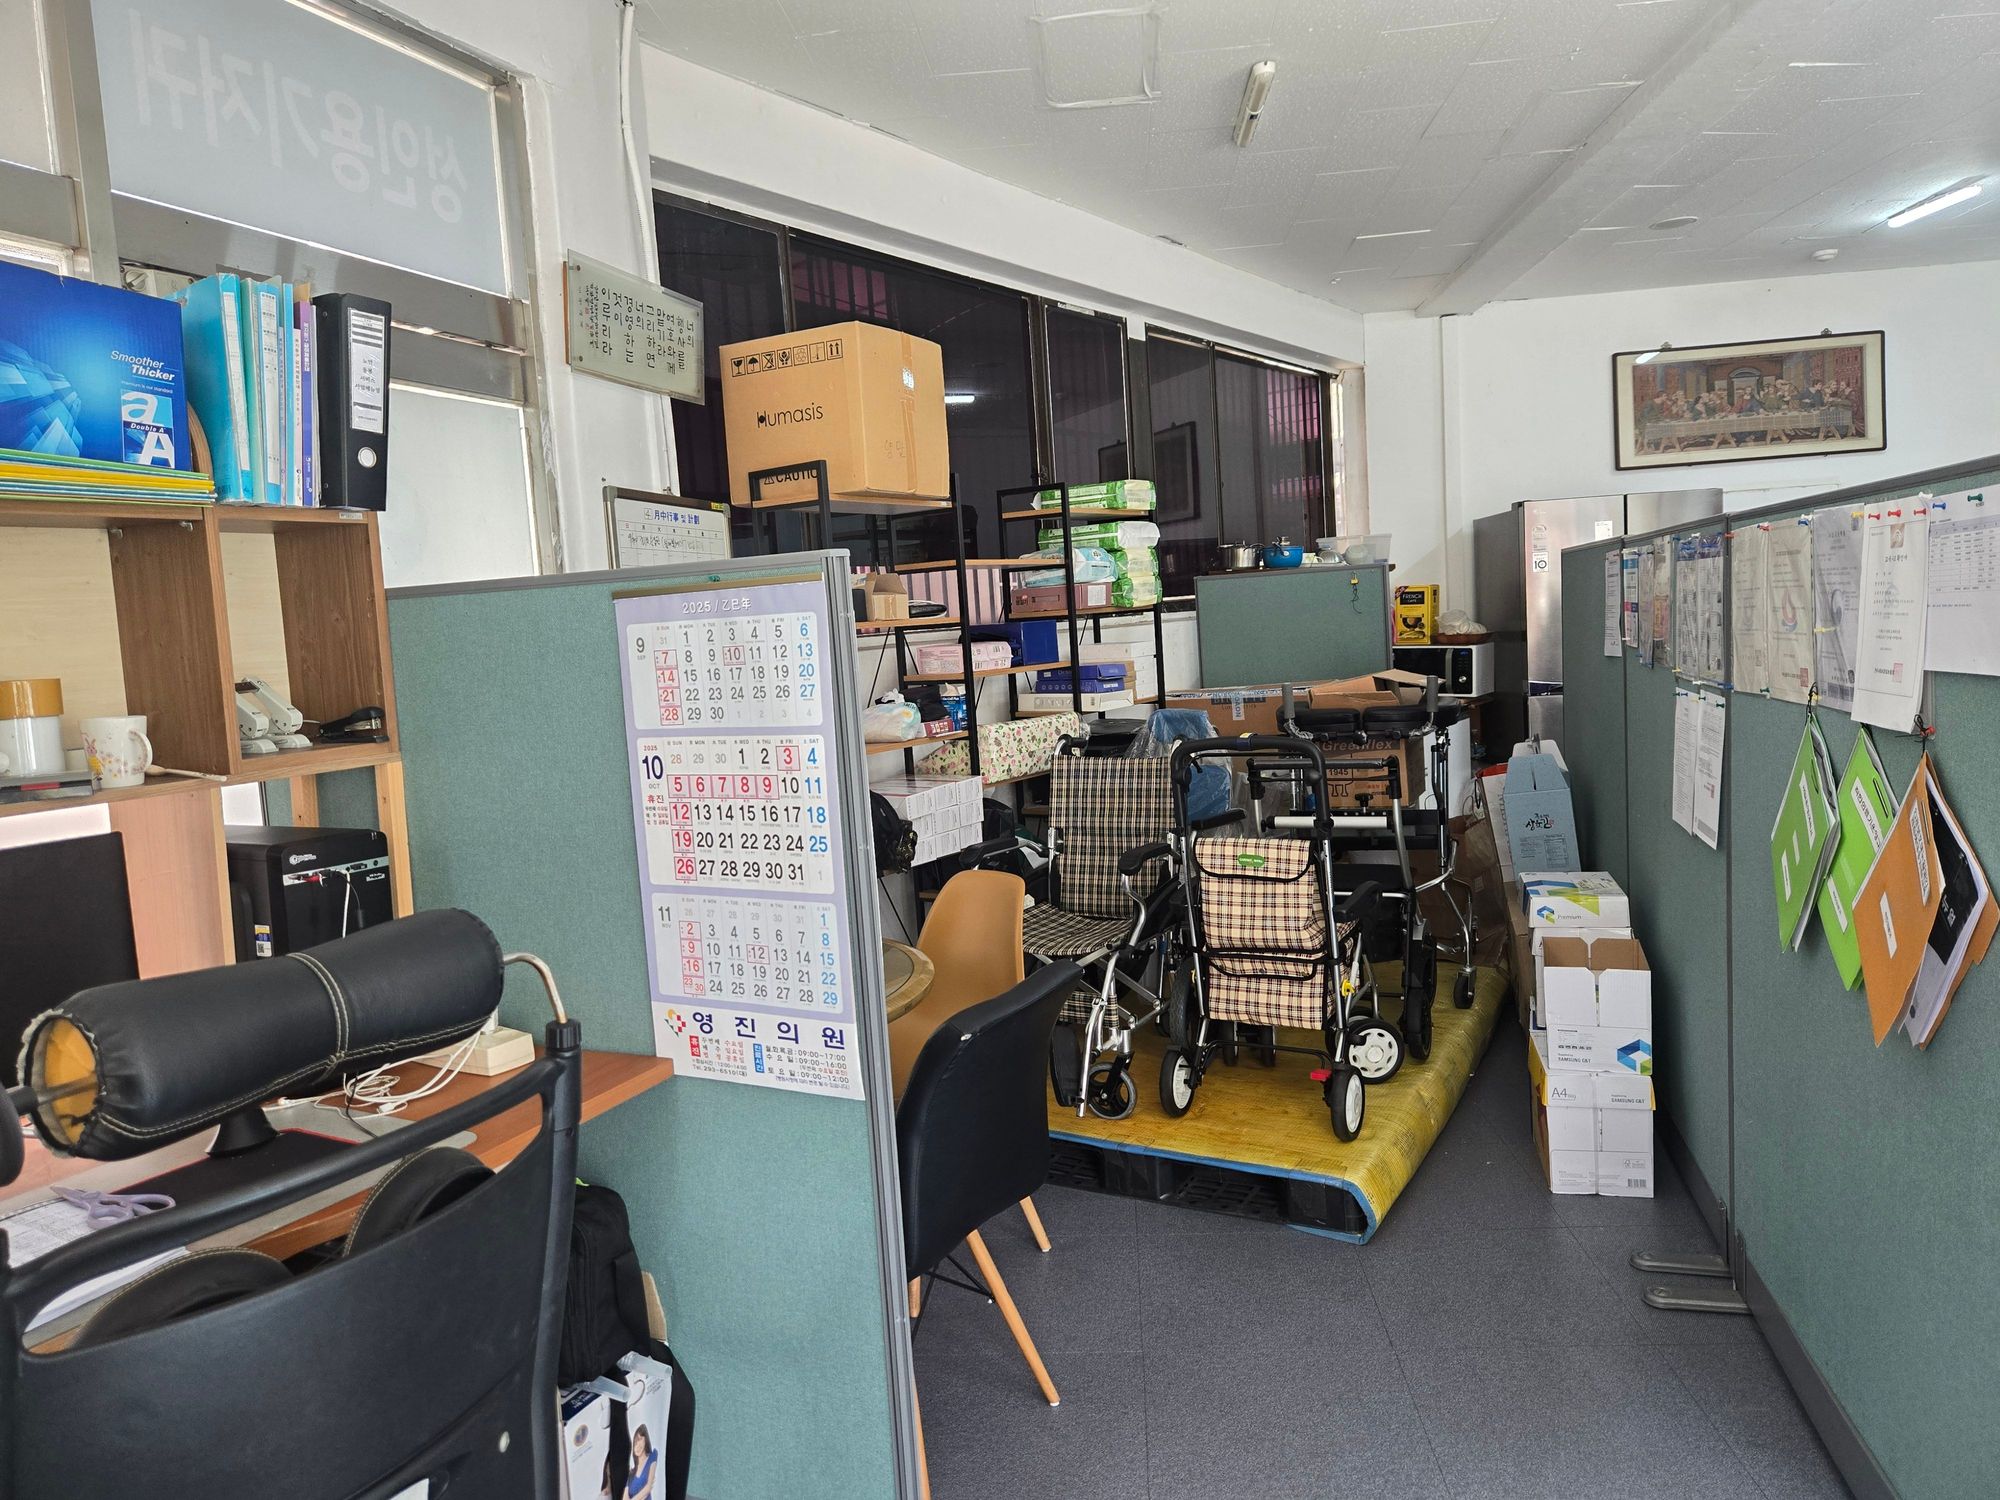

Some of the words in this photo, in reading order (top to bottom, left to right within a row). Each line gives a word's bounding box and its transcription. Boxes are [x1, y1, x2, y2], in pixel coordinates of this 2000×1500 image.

[601, 287, 612, 356] 이루리라
[636, 301, 644, 330] 너의
[686, 320, 694, 348] 너의
[110, 350, 164, 369] Smoother
[132, 364, 174, 381] Thicker
[757, 403, 824, 428] Humasis
[130, 422, 157, 432] Double
[776, 470, 818, 483] CAUTIO
[683, 602, 711, 614] 2025
[722, 598, 752, 611] 乙巳年
[636, 637, 645, 653] 9
[684, 631, 688, 644] 1
[707, 629, 714, 642] 2
[728, 628, 735, 641] 3
[751, 626, 758, 639] 4
[775, 625, 782, 638] 5
[800, 623, 808, 636] 6
[662, 652, 668, 664] 7
[685, 650, 692, 663] 8
[708, 648, 715, 662] 9
[727, 647, 740, 661] 10
[749, 646, 761, 660] 11
[772, 644, 788, 658] 12
[798, 643, 813, 657] 13
[660, 670, 675, 683] 14
[684, 669, 697, 682] 15
[707, 668, 720, 681] 16
[729, 667, 742, 680] 17
[751, 666, 765, 679] 18
[774, 665, 789, 678] 19
[799, 663, 814, 677] 20
[662, 689, 674, 702] 21
[685, 688, 700, 701] 22
[708, 687, 722, 700] 23
[730, 686, 744, 700] 24
[752, 686, 766, 699] 25
[775, 685, 790, 698] 26
[800, 684, 815, 697] 27
[664, 706, 679, 721] 28
[687, 707, 701, 720] 29
[710, 706, 724, 720] 30
[738, 748, 745, 765] 1
[760, 748, 770, 764] 2
[783, 747, 793, 765] 3
[807, 747, 817, 765] 4
[642, 755, 663, 779] 10
[674, 777, 682, 792] 5
[696, 776, 705, 792] 6
[718, 777, 726, 792] 7
[741, 776, 750, 793] 8
[763, 777, 772, 793] 9
[781, 777, 799, 794] 10
[805, 777, 821, 794] 11
[673, 804, 690, 820] 12
[694, 804, 711, 820] 13
[717, 804, 734, 821] 14
[739, 805, 756, 821] 15
[761, 806, 778, 822] 16
[784, 806, 800, 822] 17
[807, 806, 826, 823] 18
[675, 831, 691, 847] 19
[696, 832, 714, 848] 20
[718, 832, 733, 848] 21
[741, 833, 758, 849] 22
[763, 834, 780, 851] 23
[786, 835, 804, 852] 24
[809, 835, 828, 852] 25
[677, 859, 694, 874] 26
[699, 859, 715, 875] 27
[721, 860, 738, 877] 28
[743, 861, 760, 878] 29
[765, 862, 783, 879] 30
[788, 864, 803, 880] 31
[658, 906, 672, 921] 11
[821, 913, 826, 926] 1
[687, 922, 694, 935] 2
[708, 924, 715, 936] 3
[731, 926, 738, 938] 4
[753, 927, 760, 940] 5
[776, 929, 782, 942] 6
[798, 931, 805, 944] 7
[822, 933, 830, 946] 8
[688, 942, 695, 953] 9
[707, 942, 720, 956] 10
[729, 944, 740, 957] 11
[751, 946, 765, 959] 12
[774, 948, 788, 962] 13
[796, 950, 811, 964] 14
[820, 952, 834, 966] 15
[686, 959, 700, 972] 16
[708, 961, 721, 974] 17
[730, 963, 744, 976] 18
[753, 965, 766, 978] 19
[775, 967, 789, 981] 20
[798, 970, 810, 983] 21
[821, 972, 836, 986] 22
[684, 977, 693, 985] 23
[695, 983, 704, 992] 30
[709, 980, 723, 993] 24
[731, 982, 745, 995] 25
[754, 984, 768, 998] 26
[776, 986, 790, 1000] 27
[799, 989, 814, 1003] 28
[823, 992, 838, 1005] 29
[1552, 1087, 1567, 1098] A4
